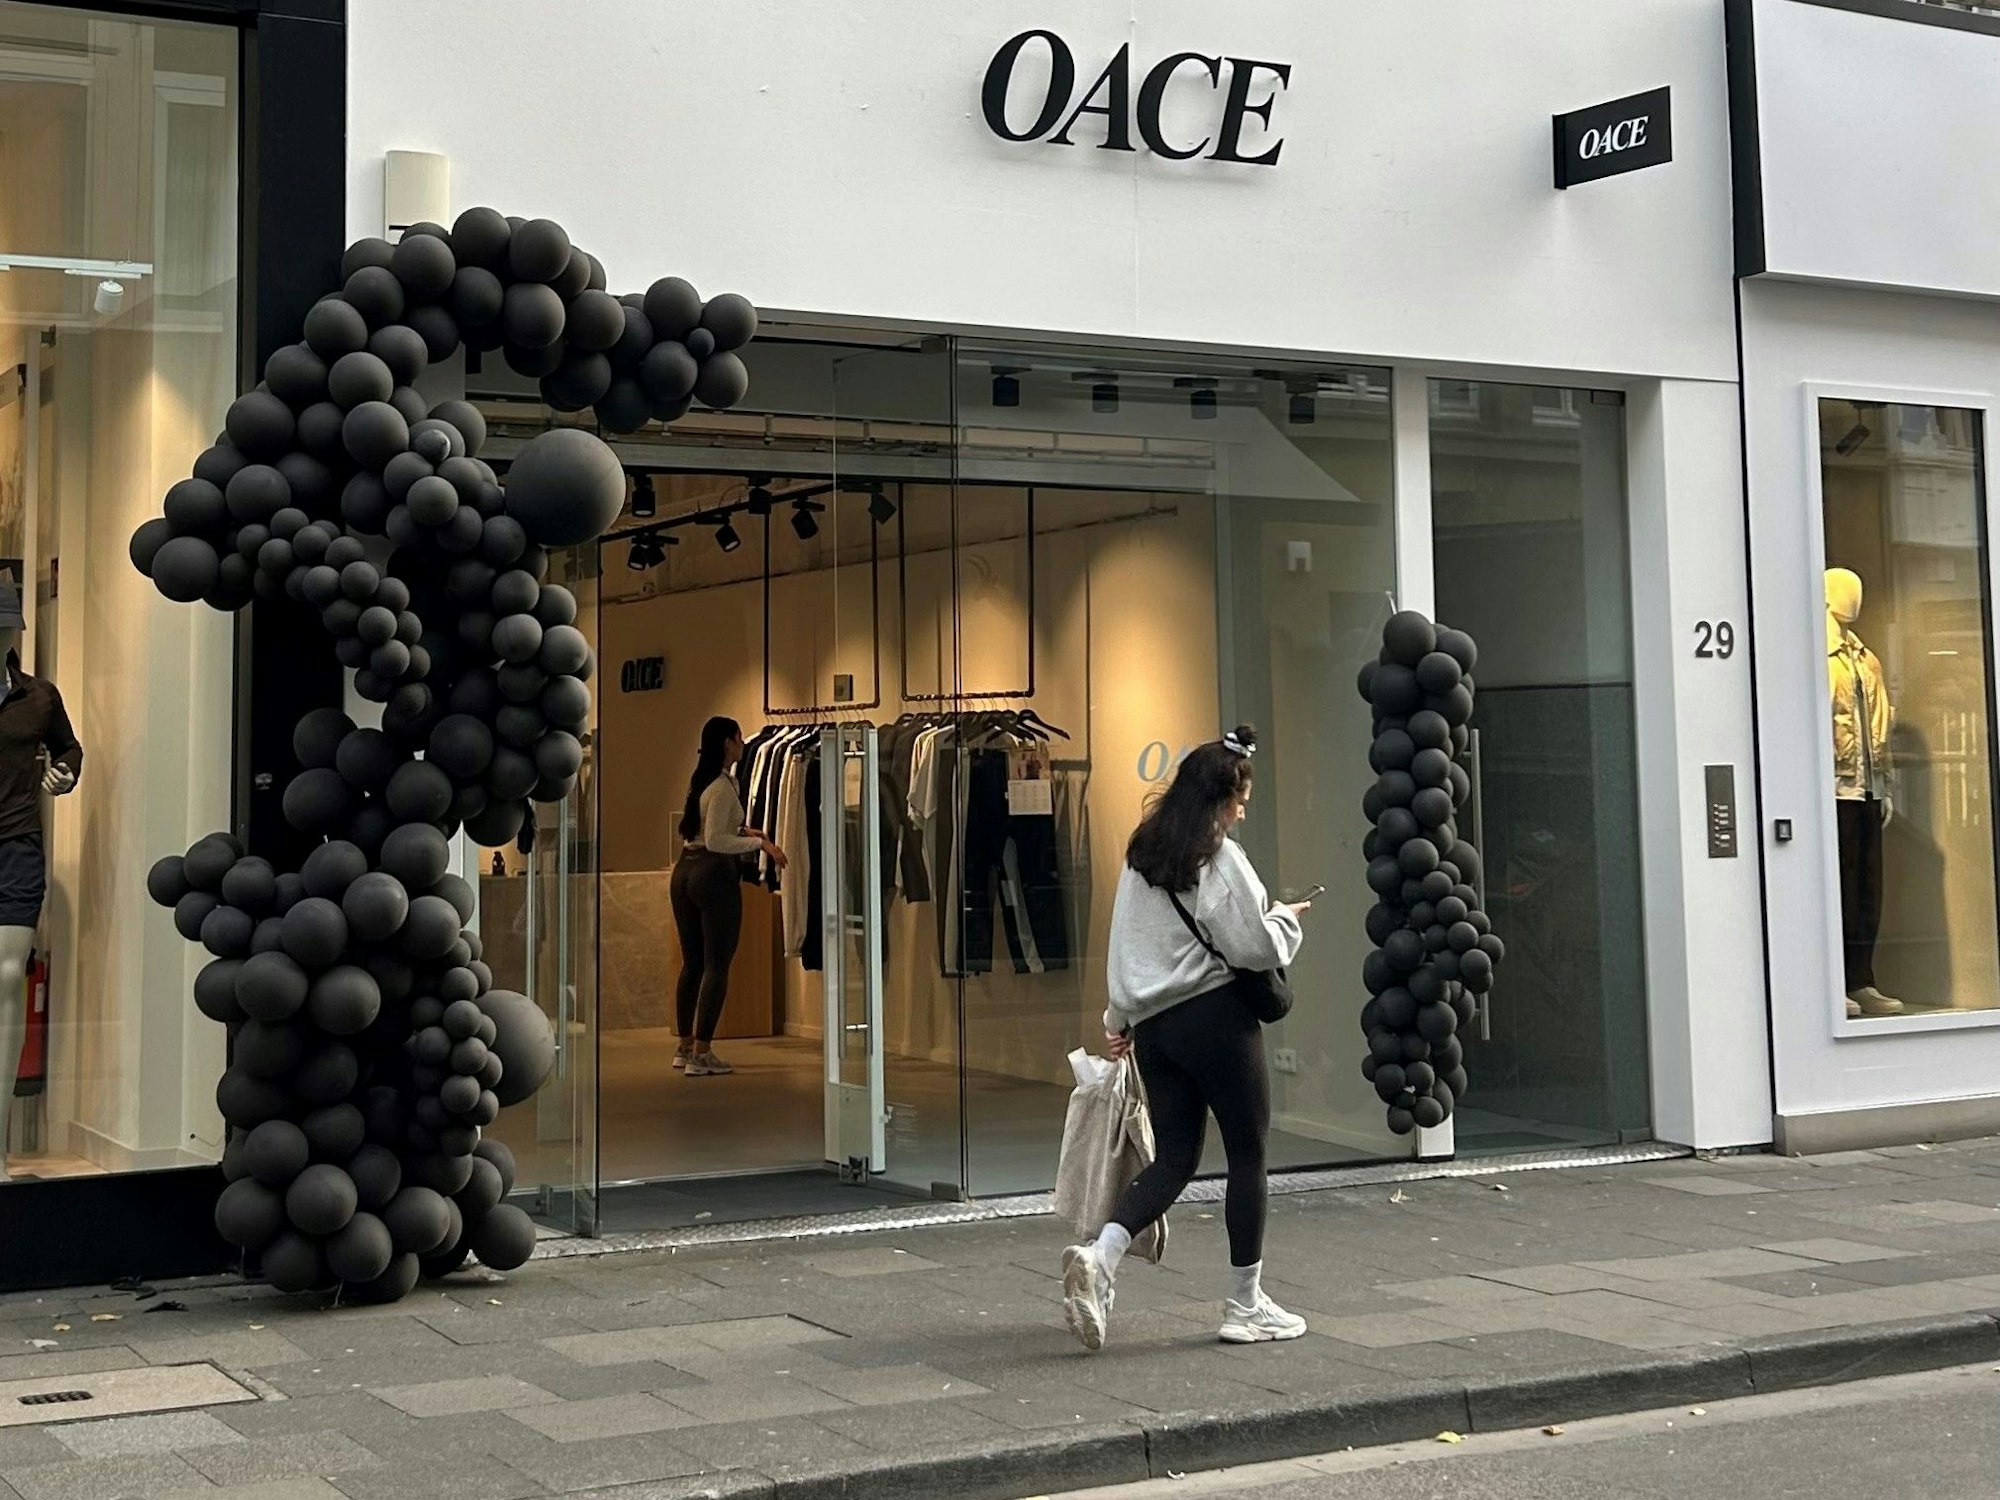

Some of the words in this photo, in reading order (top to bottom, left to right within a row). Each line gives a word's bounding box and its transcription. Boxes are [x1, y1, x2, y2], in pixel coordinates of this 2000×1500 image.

[981, 29, 1292, 166] OACE
[1579, 115, 1649, 160] OACE
[1694, 620, 1734, 659] 29
